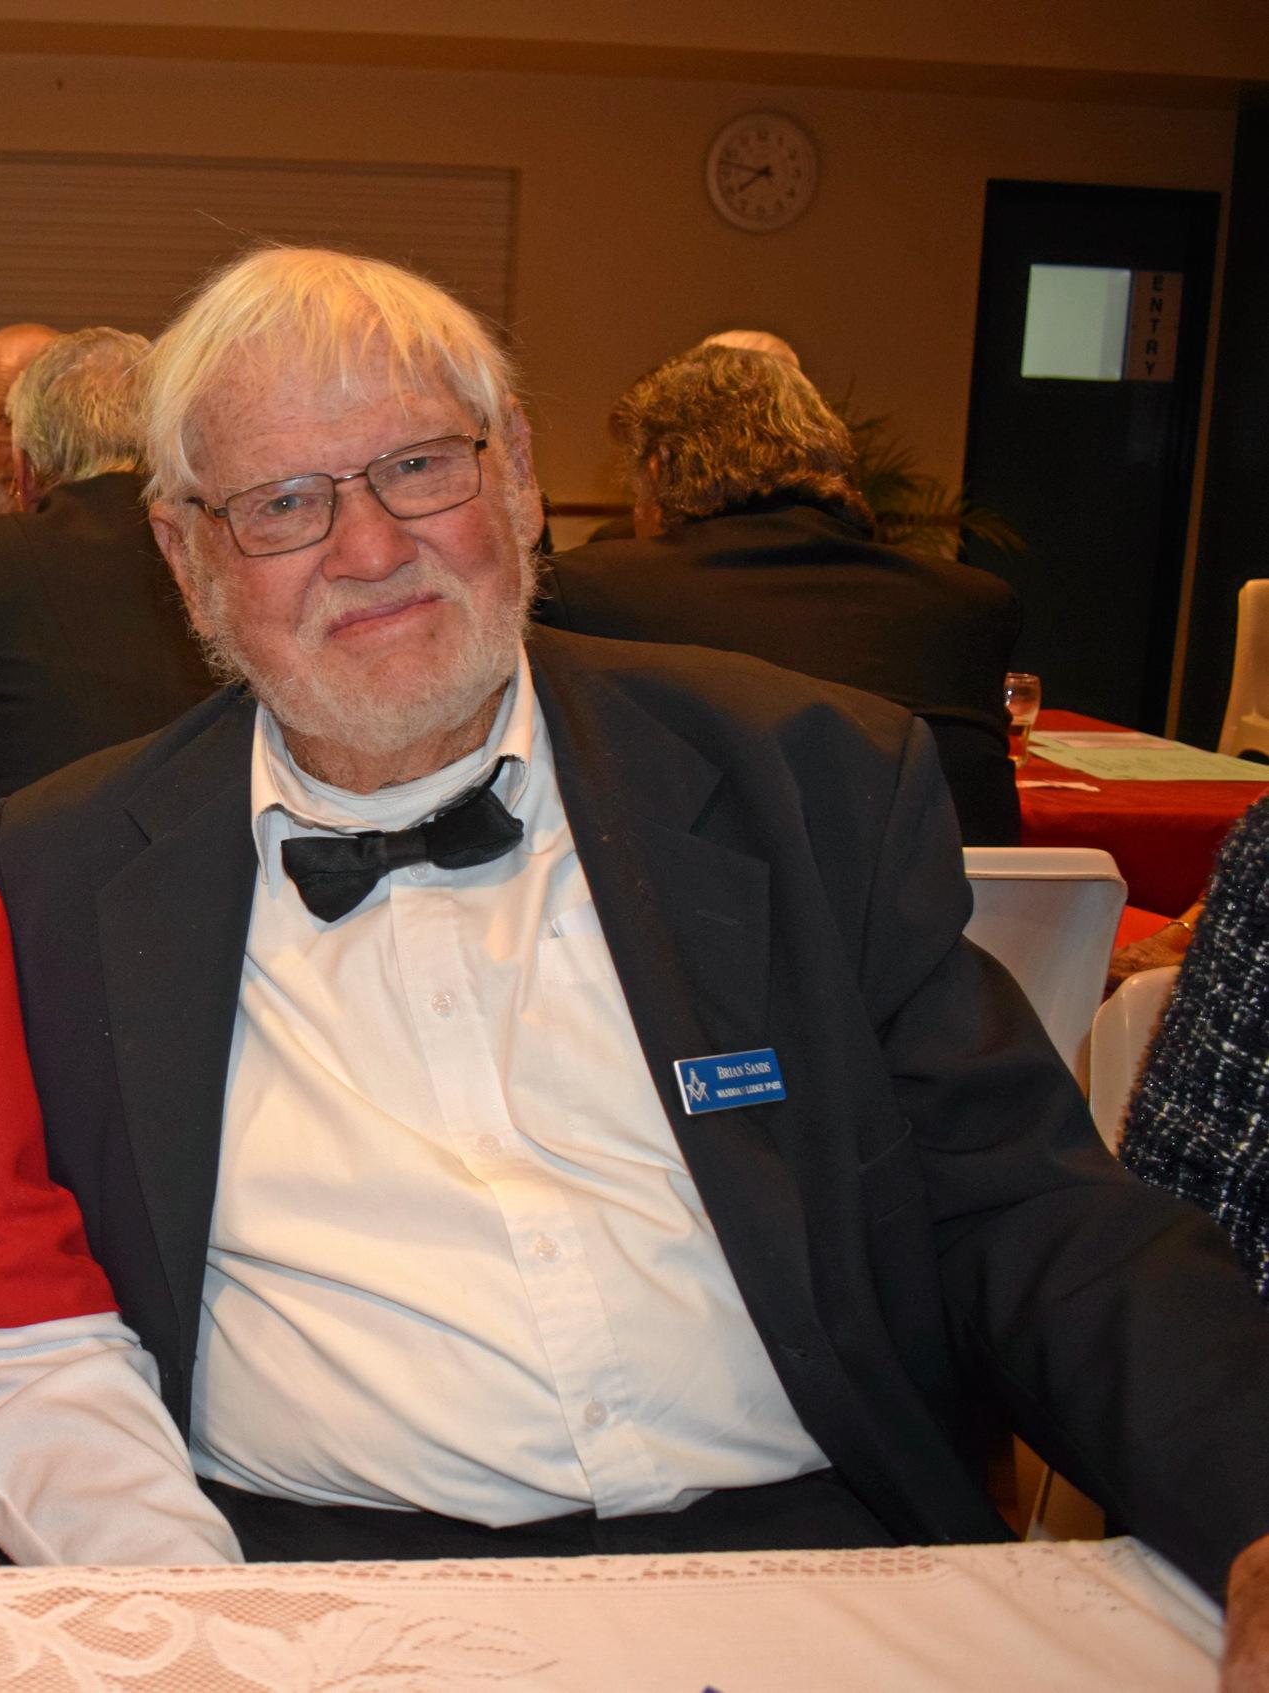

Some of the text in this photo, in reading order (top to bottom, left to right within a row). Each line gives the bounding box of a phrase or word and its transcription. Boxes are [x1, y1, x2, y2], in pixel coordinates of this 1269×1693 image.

[1145, 274, 1164, 377] ENTRY
[717, 1062, 771, 1080] BRIAN SANDS
